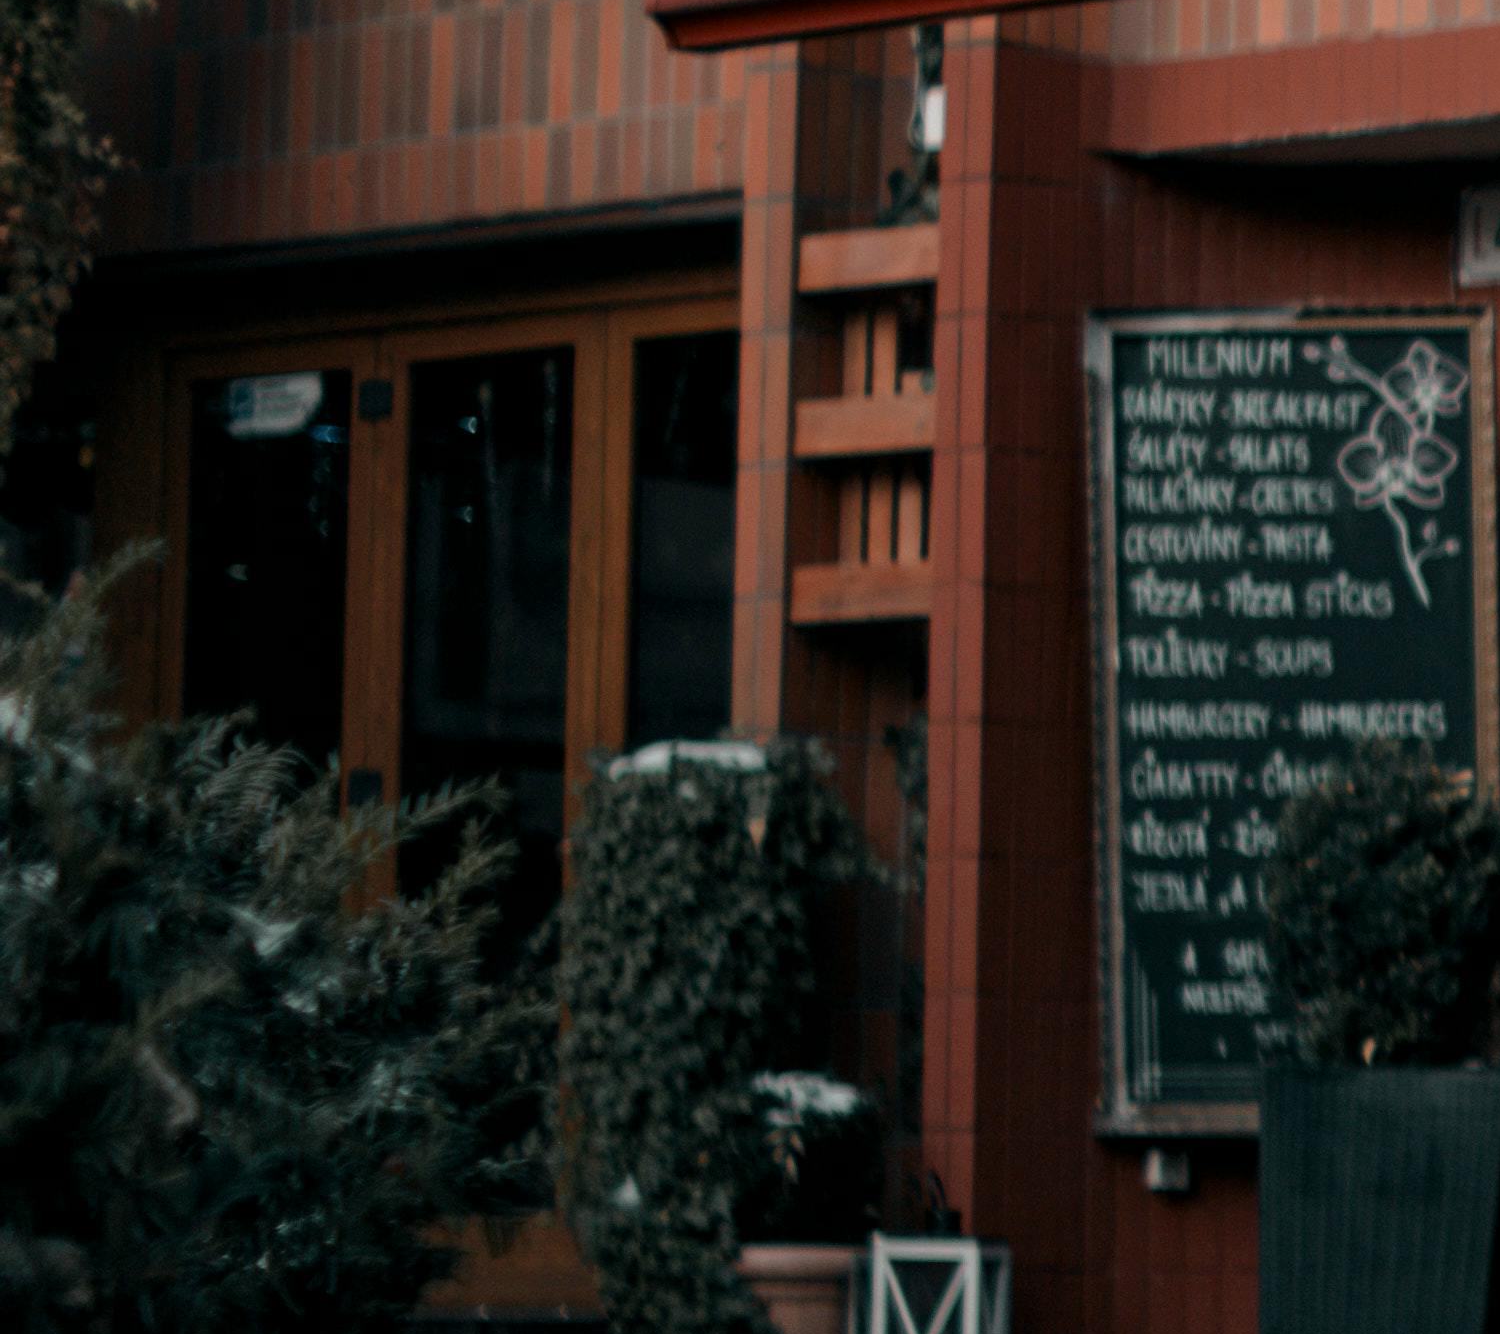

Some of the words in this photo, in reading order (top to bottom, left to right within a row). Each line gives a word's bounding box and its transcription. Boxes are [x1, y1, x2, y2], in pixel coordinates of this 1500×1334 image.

[1148, 337, 1291, 378] MILENIUM
[1230, 388, 1370, 428] BREAKFAST
[1255, 637, 1334, 677] SOUPS
